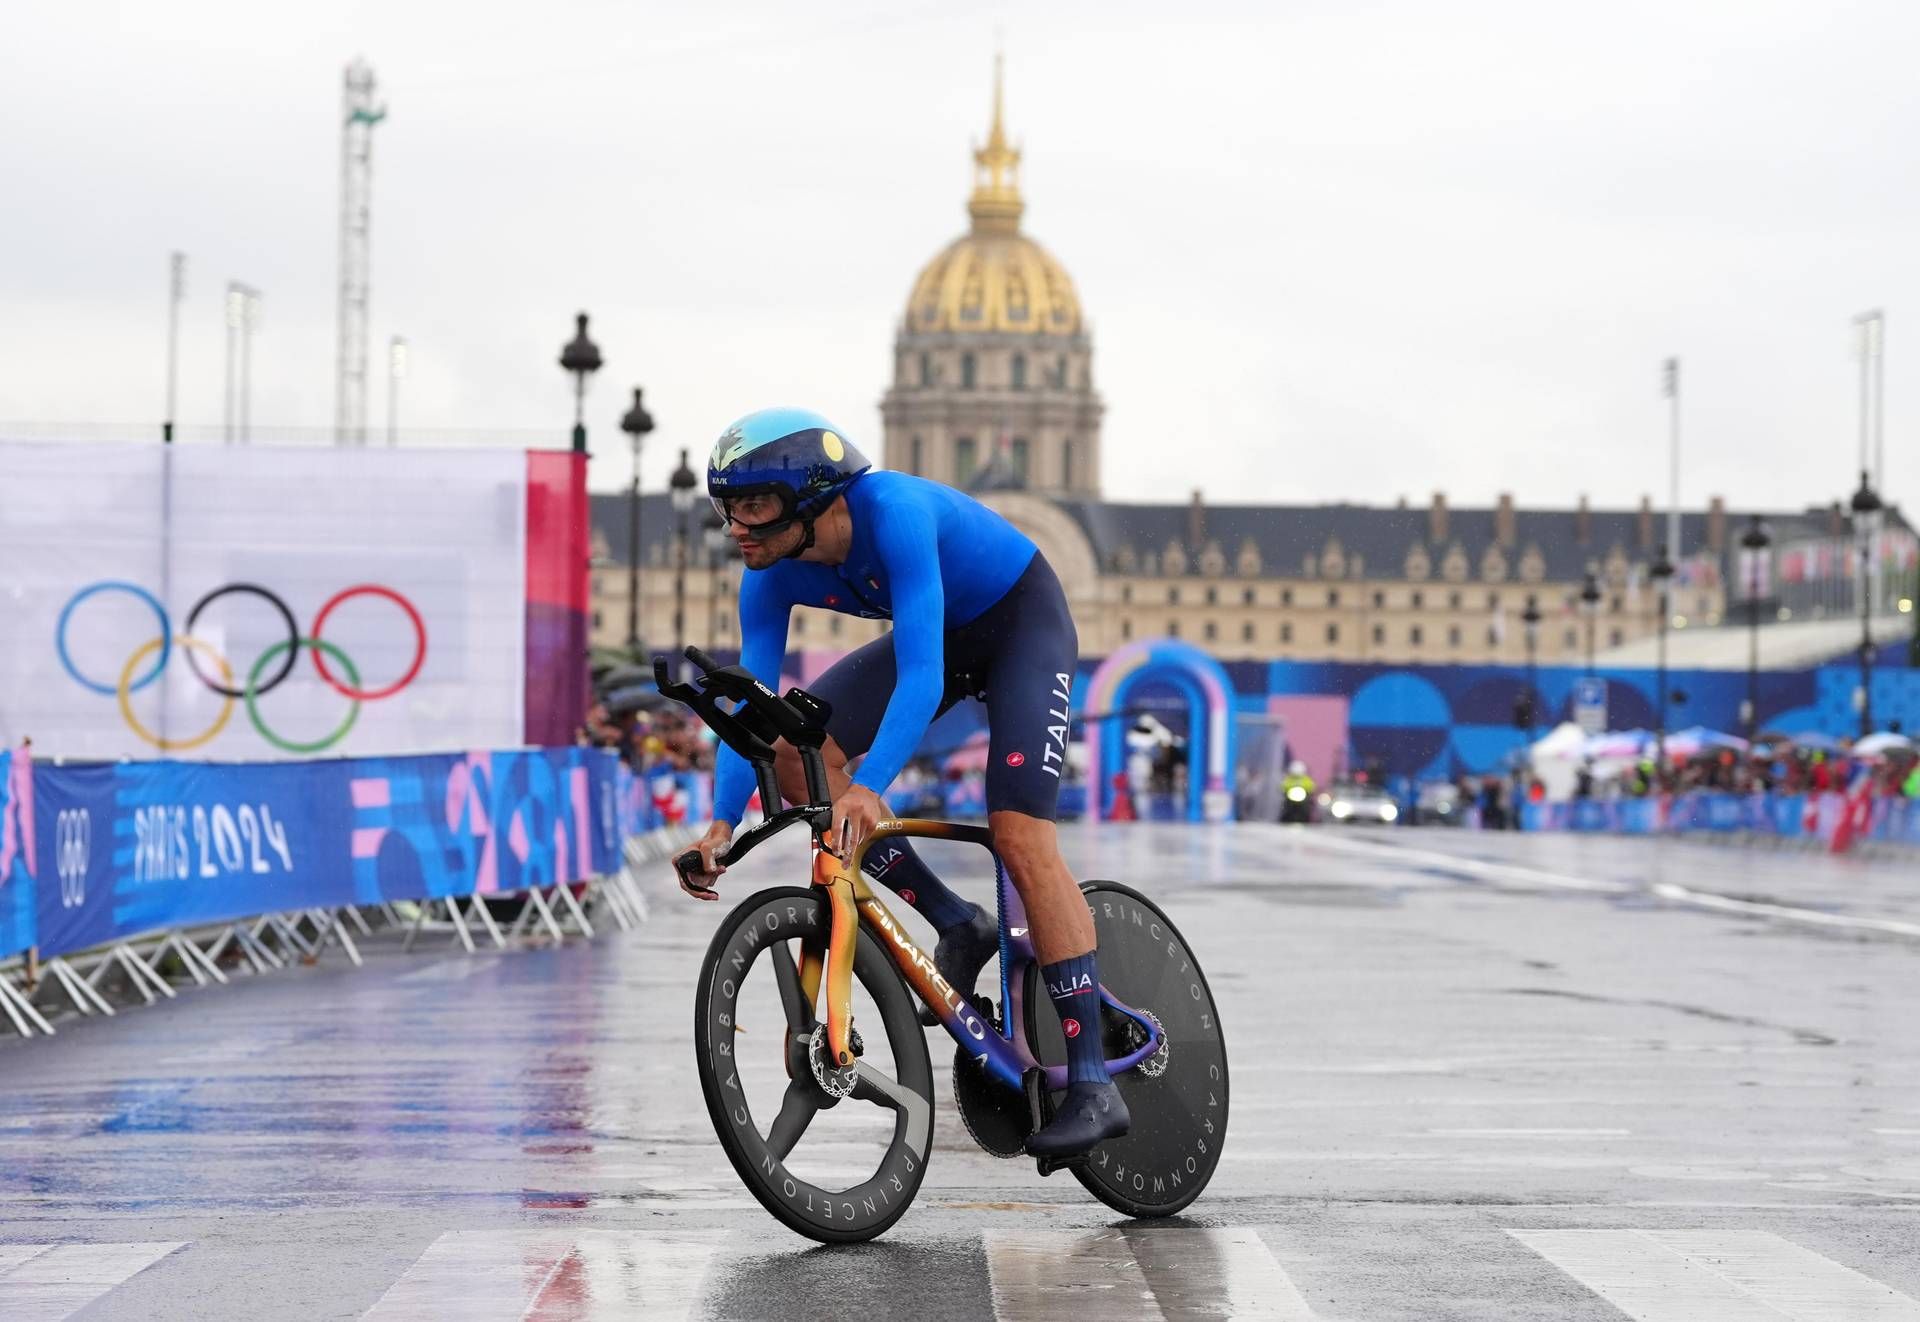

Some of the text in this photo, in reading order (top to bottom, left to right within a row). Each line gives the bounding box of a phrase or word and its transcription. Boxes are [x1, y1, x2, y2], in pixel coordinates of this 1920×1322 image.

[1042, 673, 1070, 778] ITALIA
[192, 803, 293, 878] 2024
[867, 899, 986, 1041] PINARELLO
[1088, 1064, 1219, 1193] CARBONWORK
[761, 1154, 915, 1221] PRINCETON
